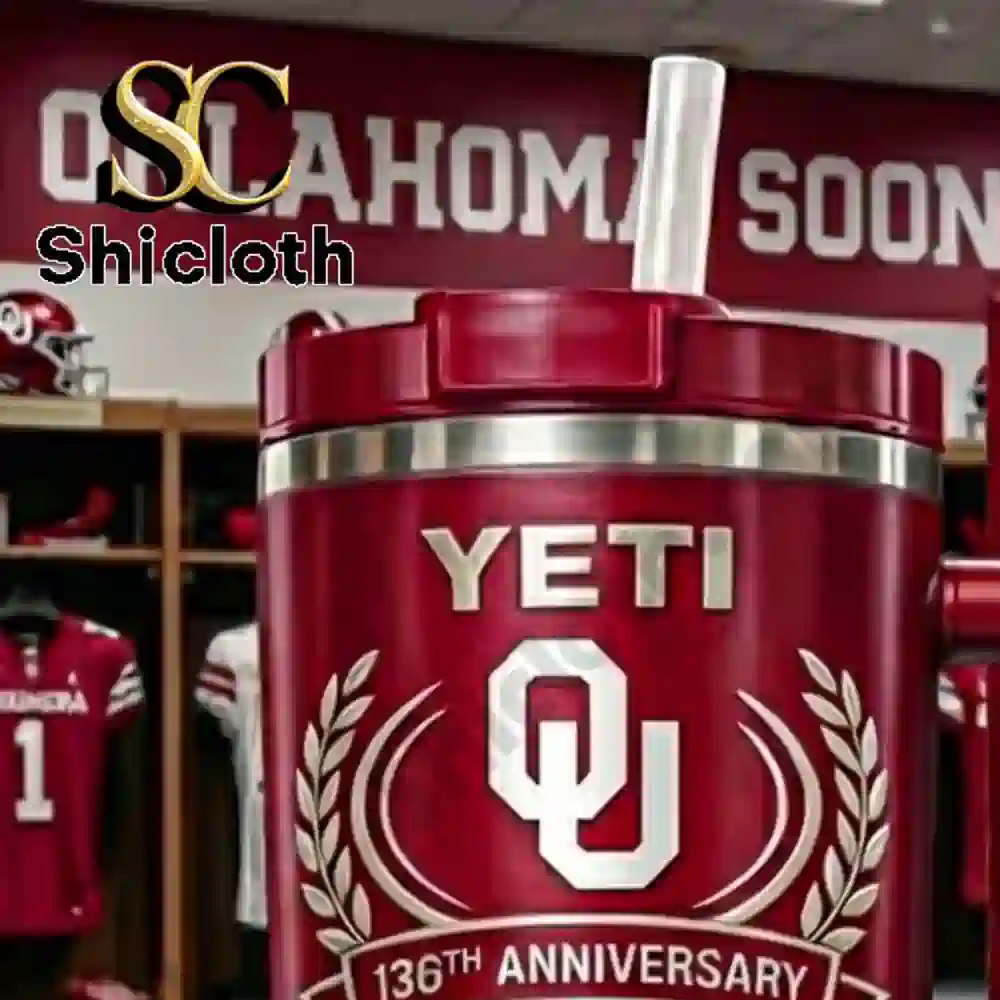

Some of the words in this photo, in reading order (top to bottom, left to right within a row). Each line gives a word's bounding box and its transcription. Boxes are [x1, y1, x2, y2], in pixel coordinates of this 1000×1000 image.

[421, 523, 733, 611] YETI
[14, 719, 53, 821] 1
[487, 638, 680, 890] OU
